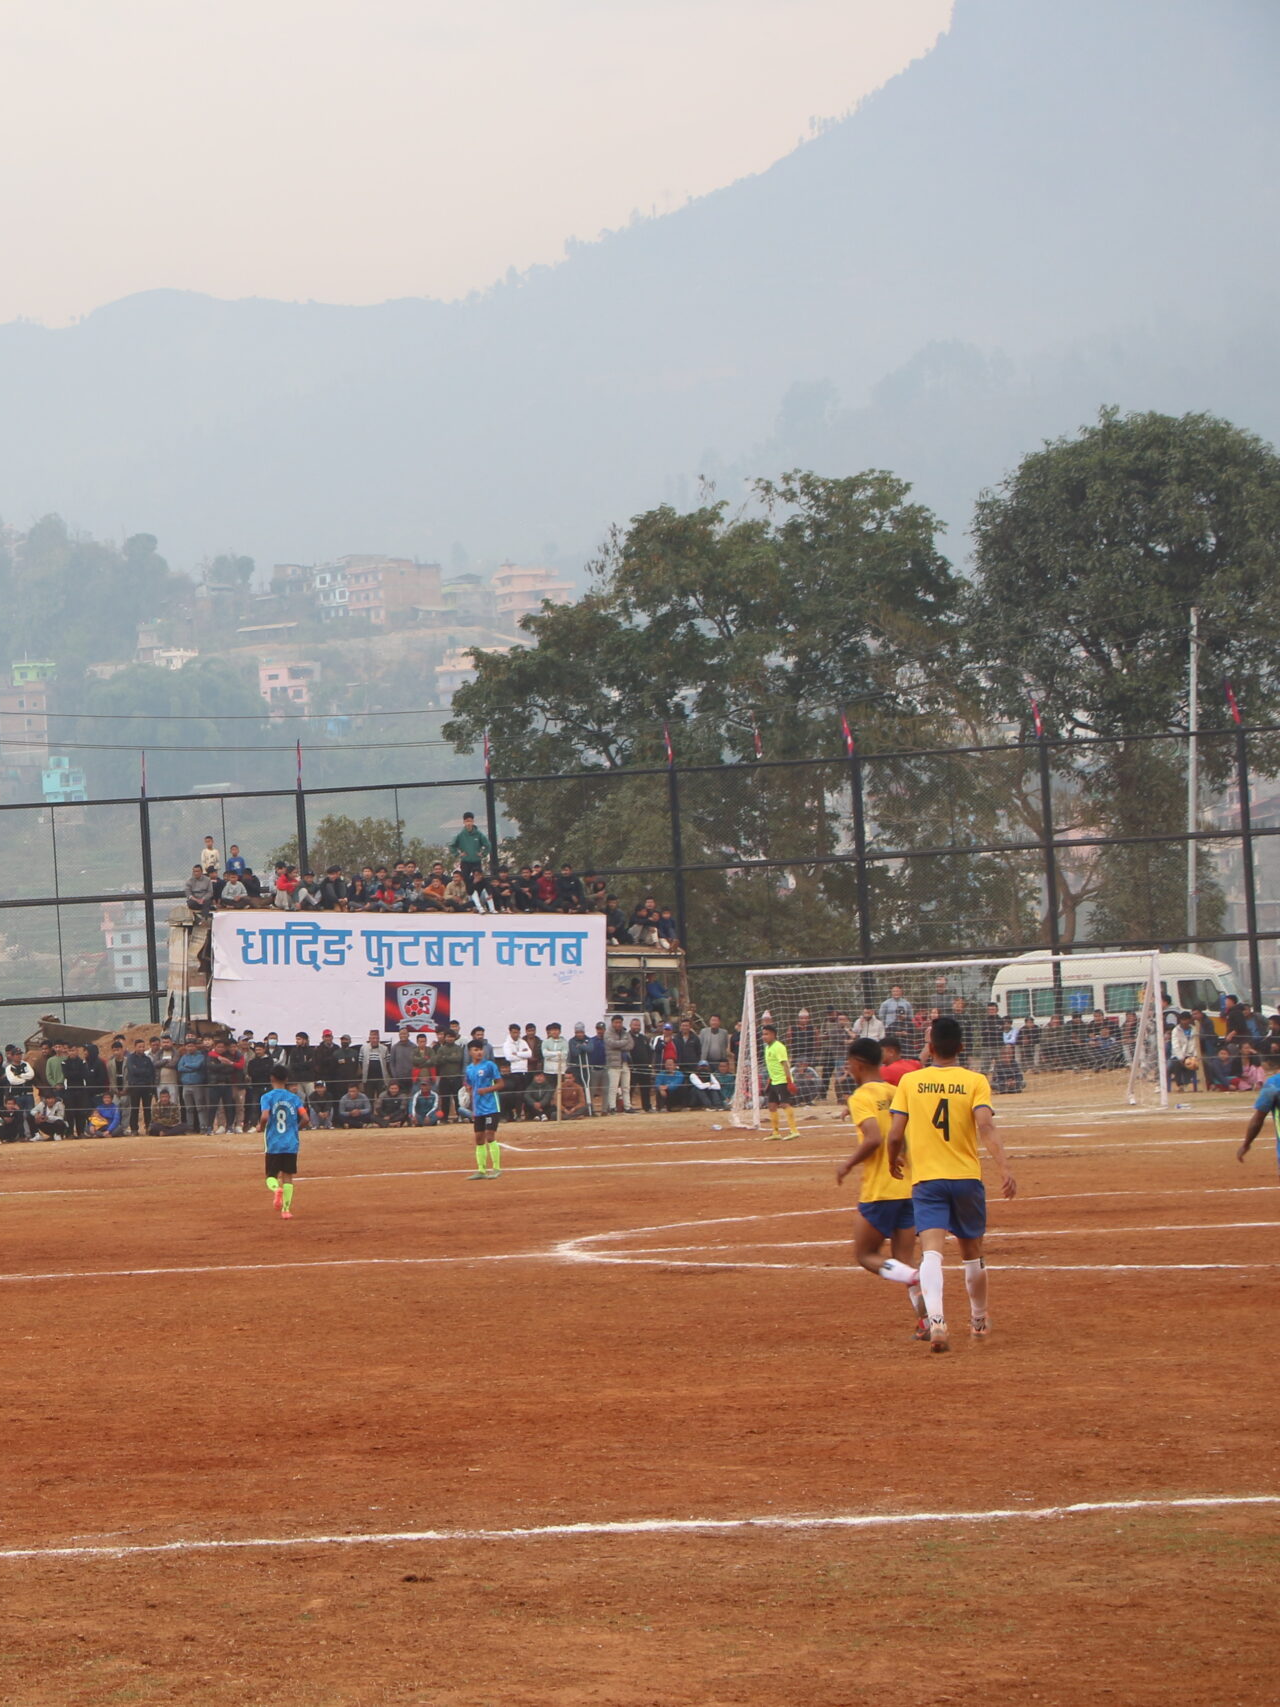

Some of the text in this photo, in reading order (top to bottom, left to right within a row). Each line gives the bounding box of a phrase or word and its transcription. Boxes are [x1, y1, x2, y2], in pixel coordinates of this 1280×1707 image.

[360, 929, 486, 977] फुटबल
[491, 931, 588, 967] क्लब
[917, 1082, 967, 1095] SHIVA DAL
[276, 1109, 287, 1134] 8
[931, 1098, 950, 1142] 4
